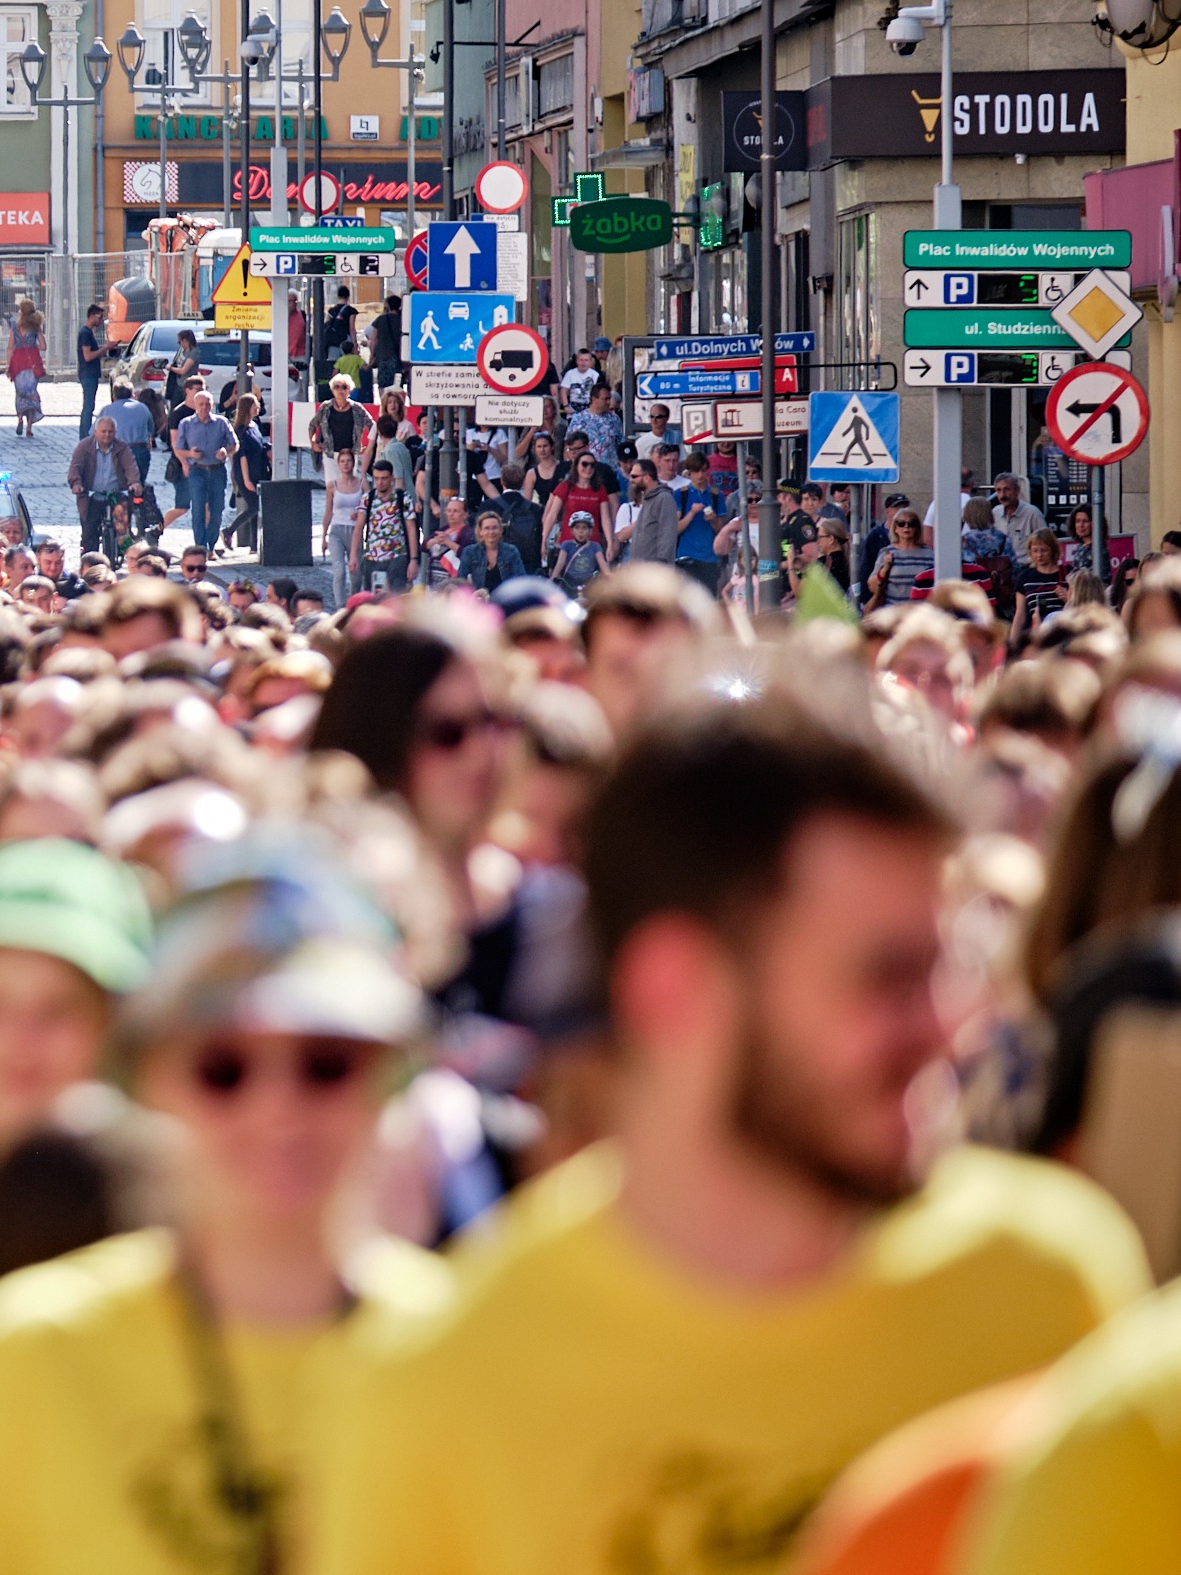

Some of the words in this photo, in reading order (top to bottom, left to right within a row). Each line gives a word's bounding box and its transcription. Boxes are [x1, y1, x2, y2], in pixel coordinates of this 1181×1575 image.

[953, 92, 1100, 135] STODOLA
[582, 211, 662, 236] żabka
[259, 234, 279, 244] Plac
[282, 234, 330, 244] Inwalidów
[332, 234, 385, 246] Wojennych
[919, 243, 951, 256] Plac
[955, 243, 1029, 257] Inwalidów
[1032, 243, 1114, 259] Wojennych
[950, 277, 969, 302] P
[965, 323, 983, 335] ul.
[987, 322, 1066, 335] Studzienn
[951, 356, 970, 380] P
[426, 370, 452, 378] strefie
[455, 370, 481, 378] zamie
[688, 374, 730, 383] Informacja
[425, 381, 479, 391] skrzyżowania
[688, 384, 732, 392] Turystyczna
[442, 391, 476, 399] równorz
[501, 400, 530, 408] dotyczy
[484, 415, 533, 423] komunalnych
[776, 420, 803, 428] uzeum
